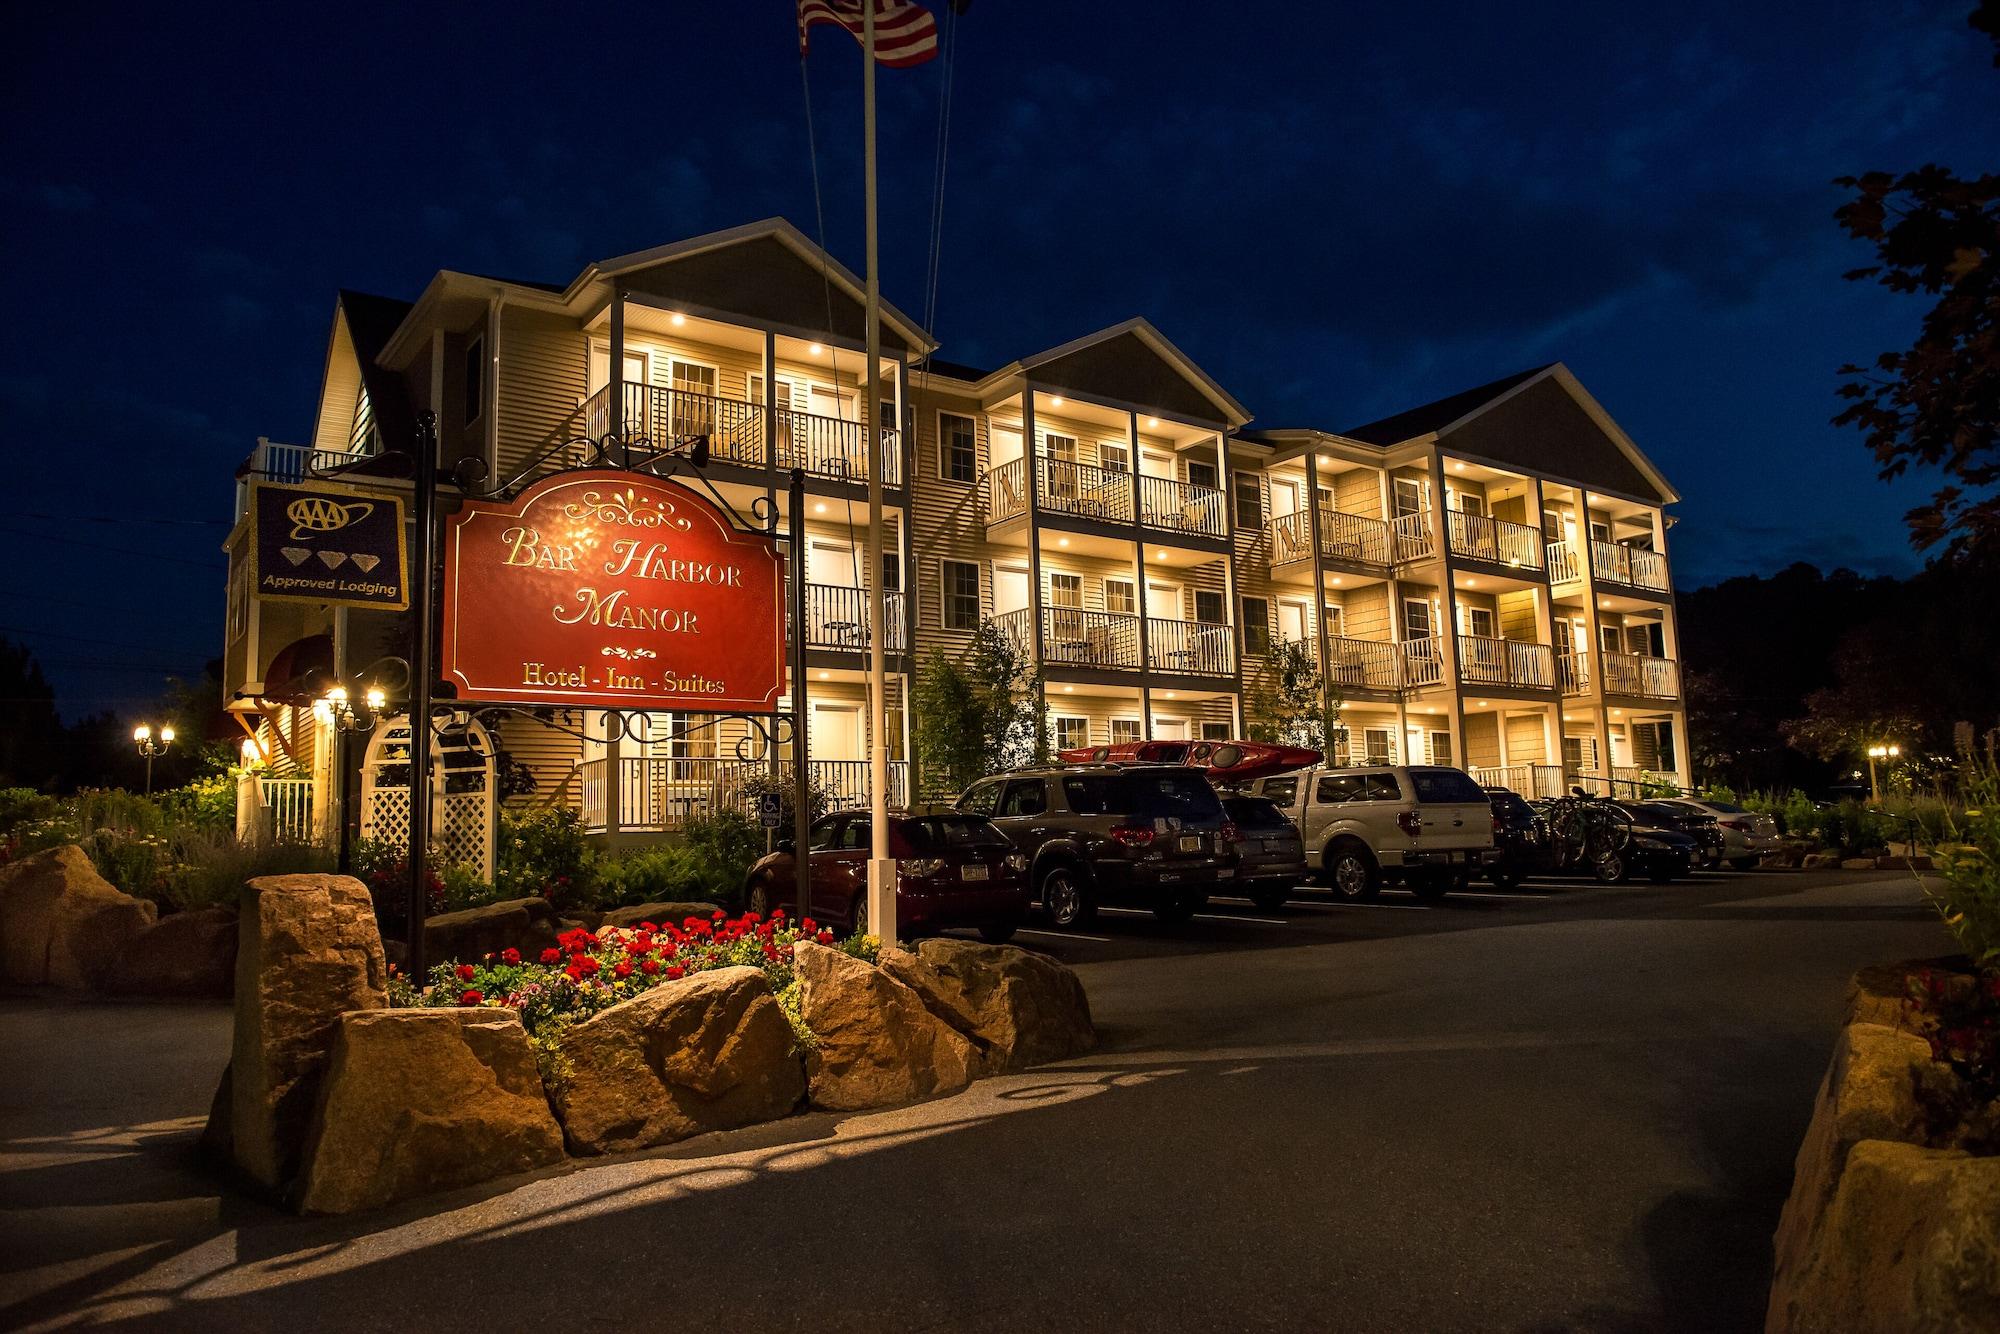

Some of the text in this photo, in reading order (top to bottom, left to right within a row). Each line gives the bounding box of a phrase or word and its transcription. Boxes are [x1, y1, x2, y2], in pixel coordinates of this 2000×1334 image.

[293, 499, 344, 530] AAA
[501, 526, 744, 588] BAR HARBOR
[262, 574, 398, 598] Approved Lodging
[553, 586, 701, 634] MANOR
[522, 661, 588, 688] Hotel
[606, 667, 646, 690] Inn
[663, 670, 726, 694] Suites
